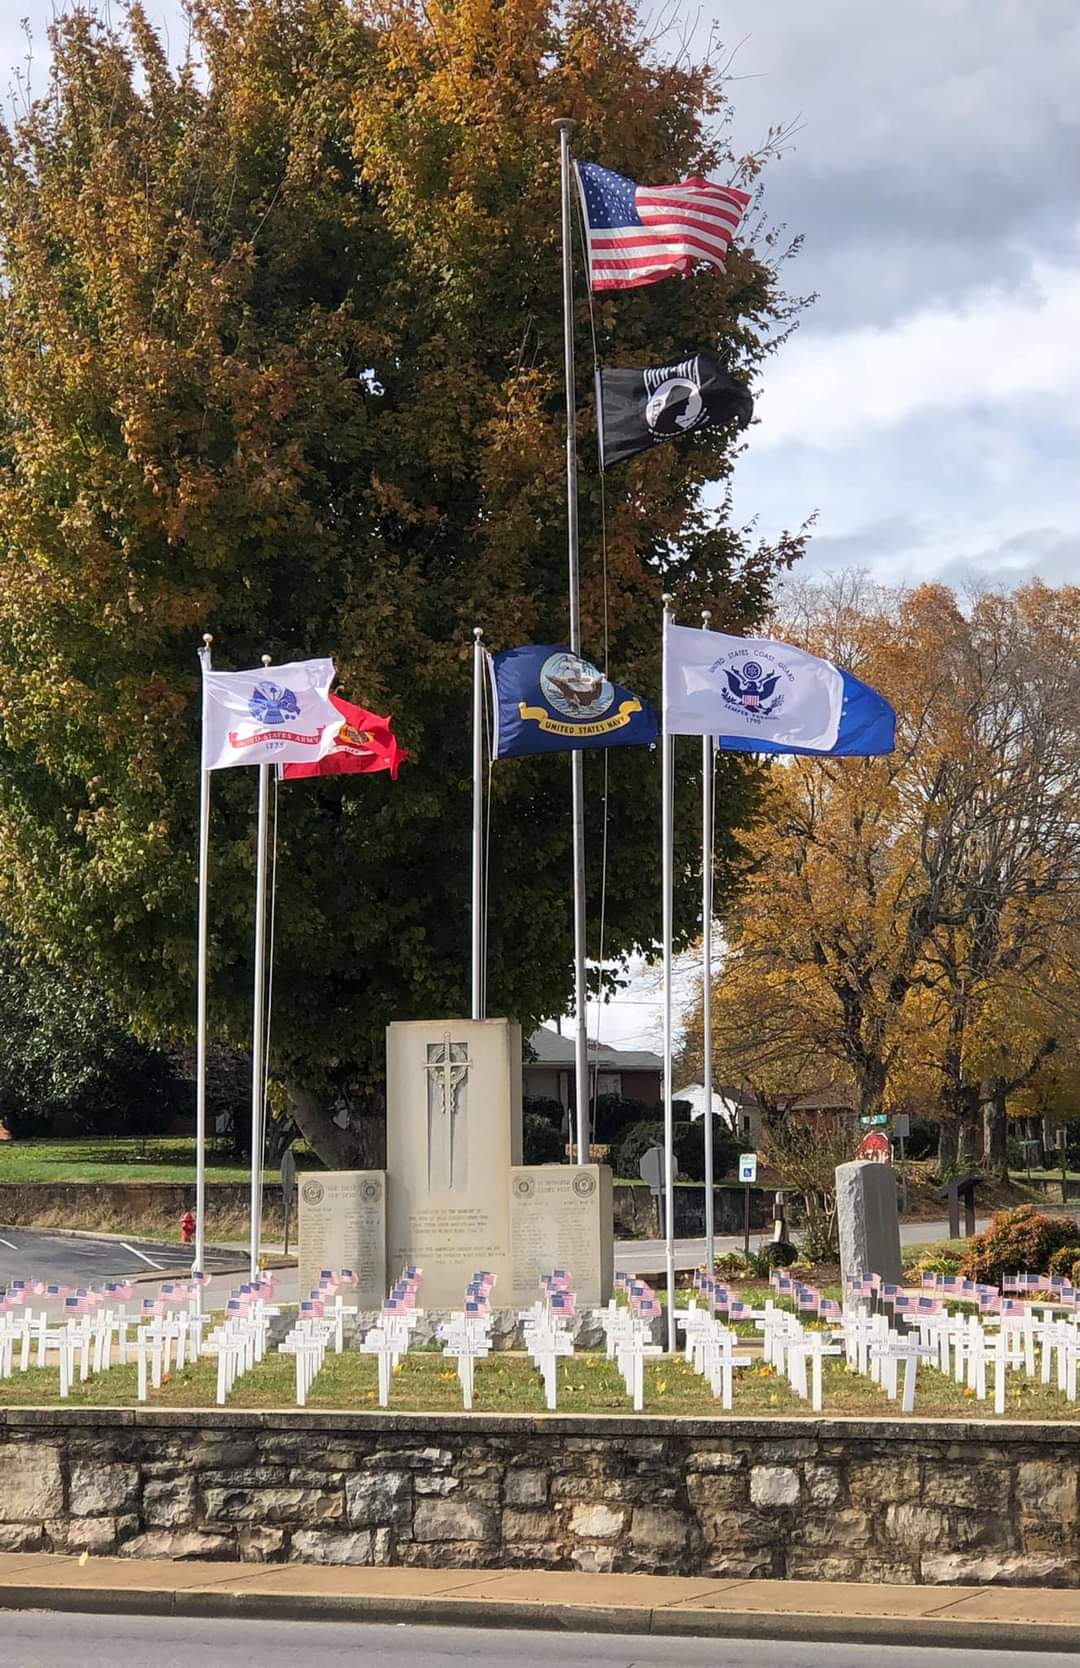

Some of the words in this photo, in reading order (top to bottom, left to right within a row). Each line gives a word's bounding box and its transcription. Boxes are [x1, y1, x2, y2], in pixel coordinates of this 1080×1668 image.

[643, 368, 671, 401] POW
[708, 657, 726, 673] UNITED
[727, 649, 749, 660] STATES
[753, 649, 775, 662] COAST
[777, 662, 795, 682] GUARD
[263, 732, 292, 740] STATES
[295, 735, 319, 744] ARMY
[545, 721, 575, 735] UNITED
[578, 723, 605, 735] STATES
[607, 716, 626, 730] NAVY
